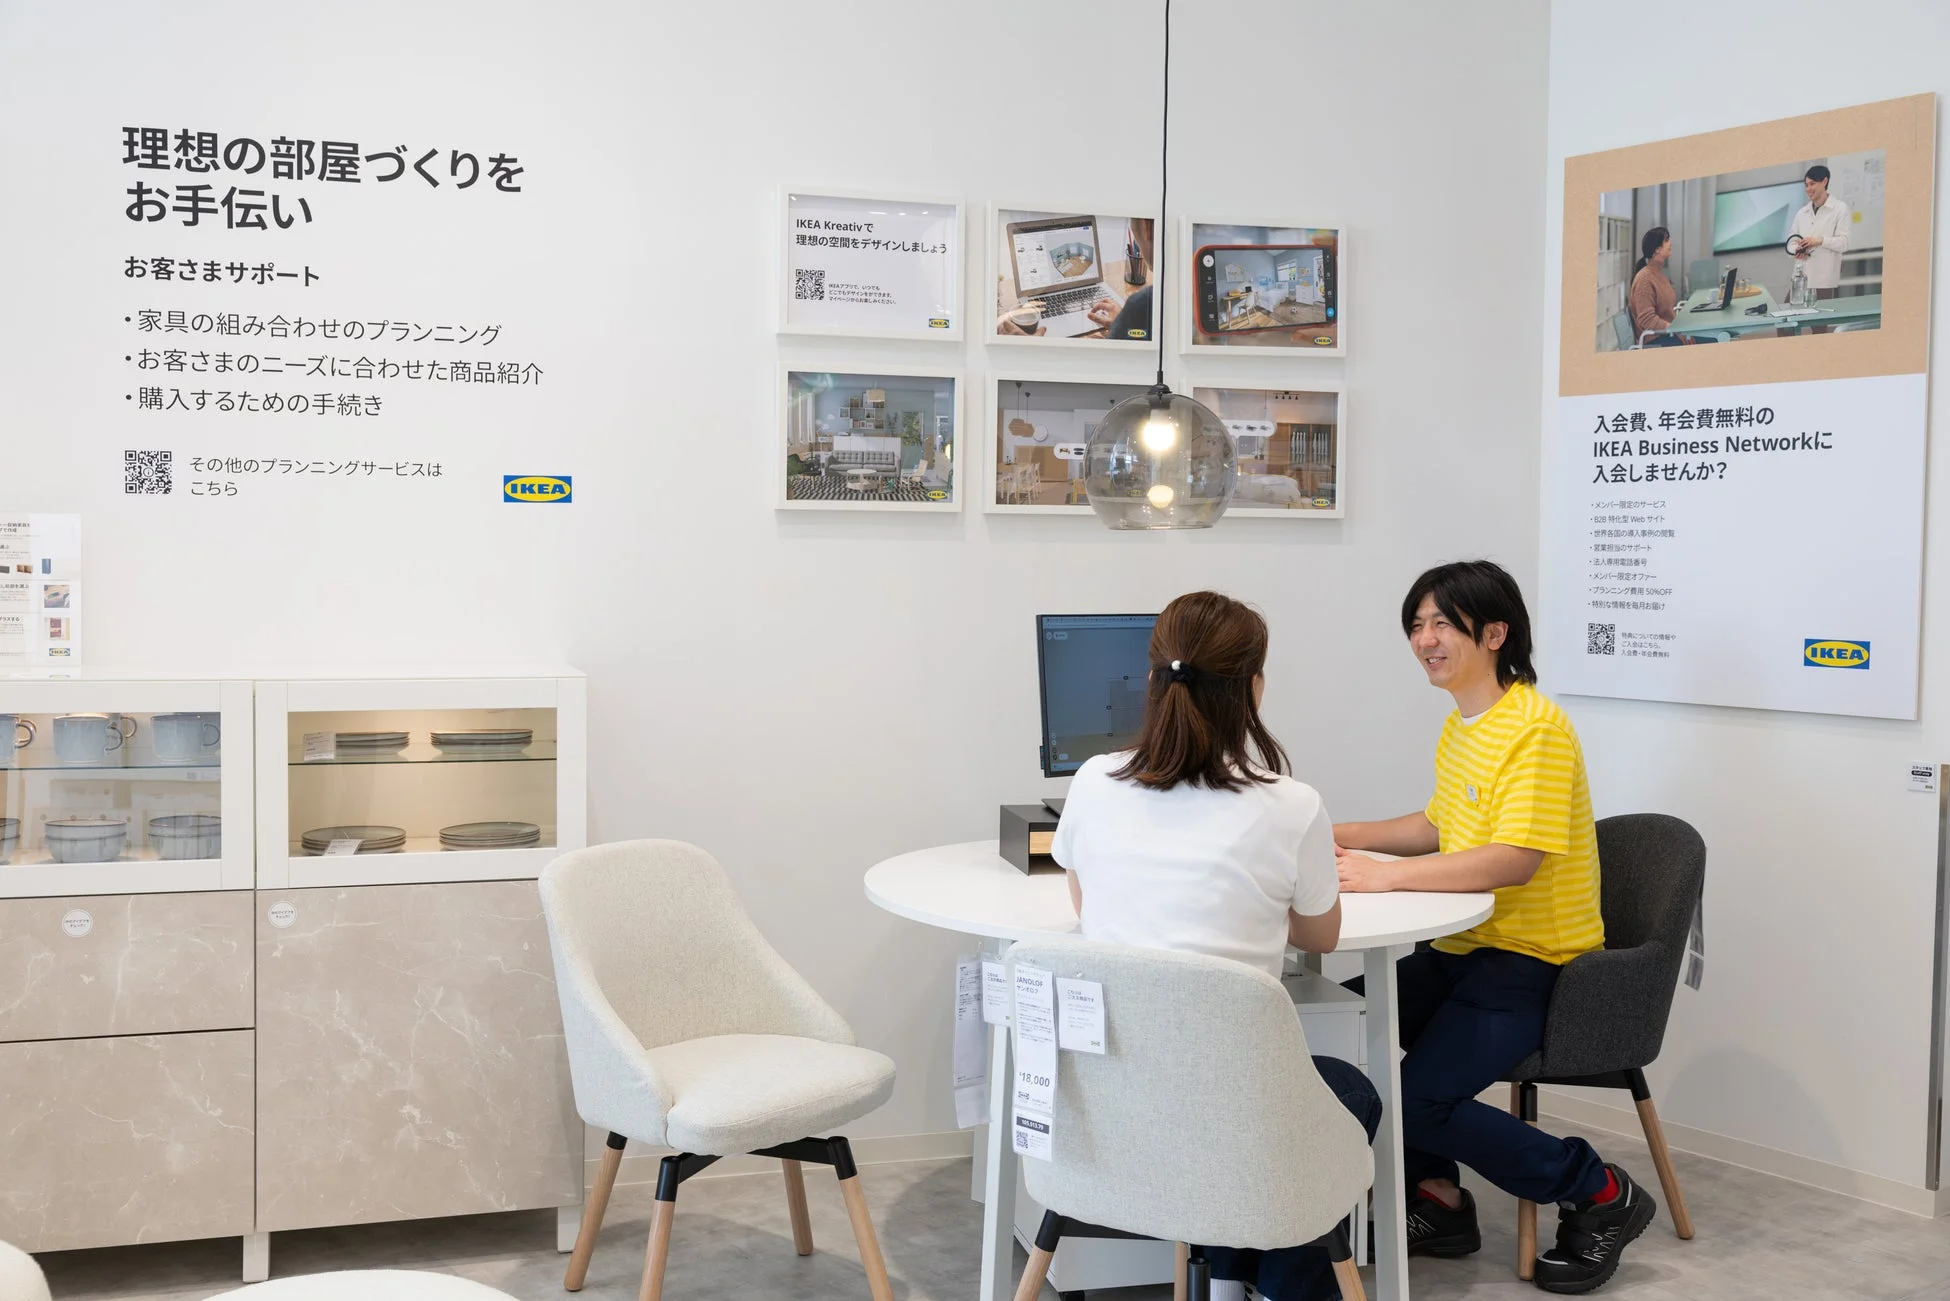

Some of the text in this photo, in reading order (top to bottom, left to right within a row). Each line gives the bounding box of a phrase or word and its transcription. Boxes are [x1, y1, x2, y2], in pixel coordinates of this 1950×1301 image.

[122, 126, 525, 193] 理想の部屋づくりを
[125, 181, 313, 231] お手伝い
[796, 219, 821, 230] IKEA
[796, 234, 947, 254] 理想の空間をデザインしましょう
[124, 256, 320, 287] お客さまサポート
[138, 308, 502, 346] 家具の組み合わせのプランニング
[138, 348, 544, 385] お客さまのニーズに合わせた商品紹介
[139, 386, 383, 416] 購入するための手続き
[1594, 405, 1775, 434] 入会費、年会費無料の
[1593, 439, 1633, 457] IKEA
[1638, 438, 1719, 456] Business
[189, 457, 443, 477] その他のプランニングサービスは
[190, 480, 238, 496] こちら
[1594, 500, 1667, 509] メンバー限定のサービス
[1647, 515, 1665, 523] サイト
[1593, 572, 1657, 581] メンバー限定オファー
[1593, 587, 1673, 596] プランニング費用 50%OFF
